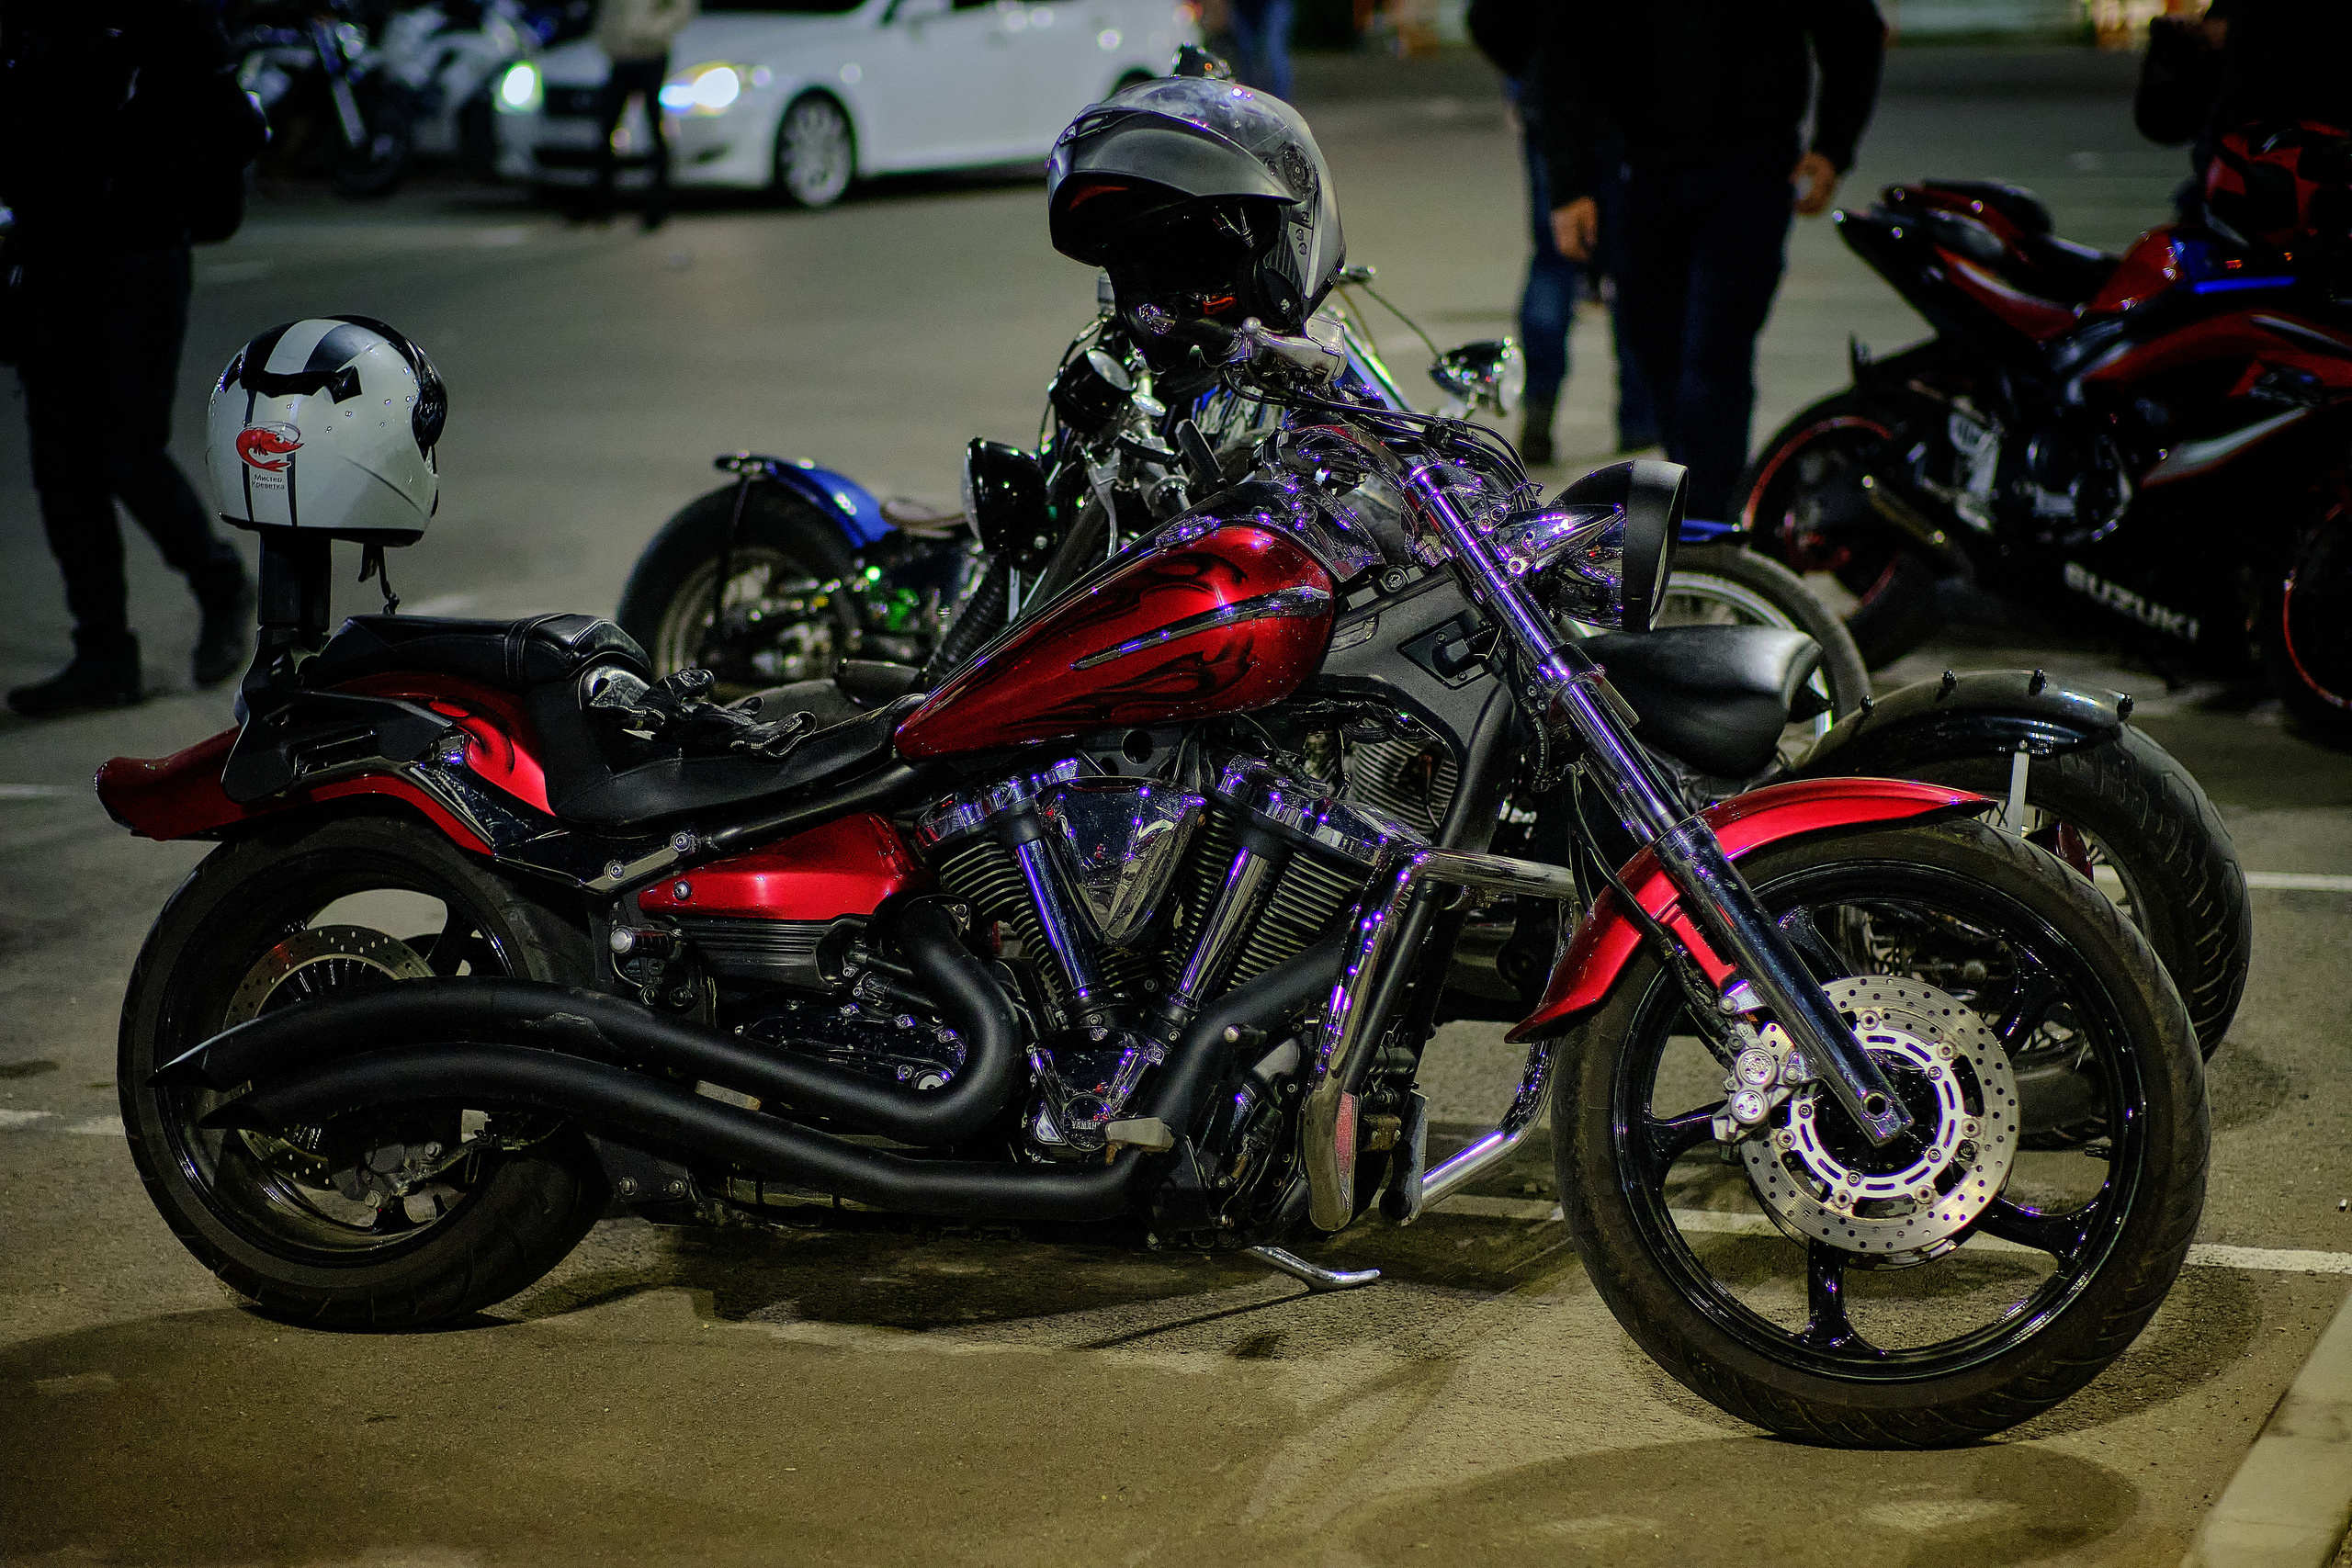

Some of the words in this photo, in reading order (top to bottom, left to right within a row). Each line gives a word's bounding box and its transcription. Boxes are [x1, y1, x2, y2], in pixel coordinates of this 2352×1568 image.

[254, 473, 282, 483] Мистер
[251, 480, 285, 490] Креветка
[2064, 561, 2199, 642] SUZUKI
[1071, 1119, 1100, 1130] YAMAH
